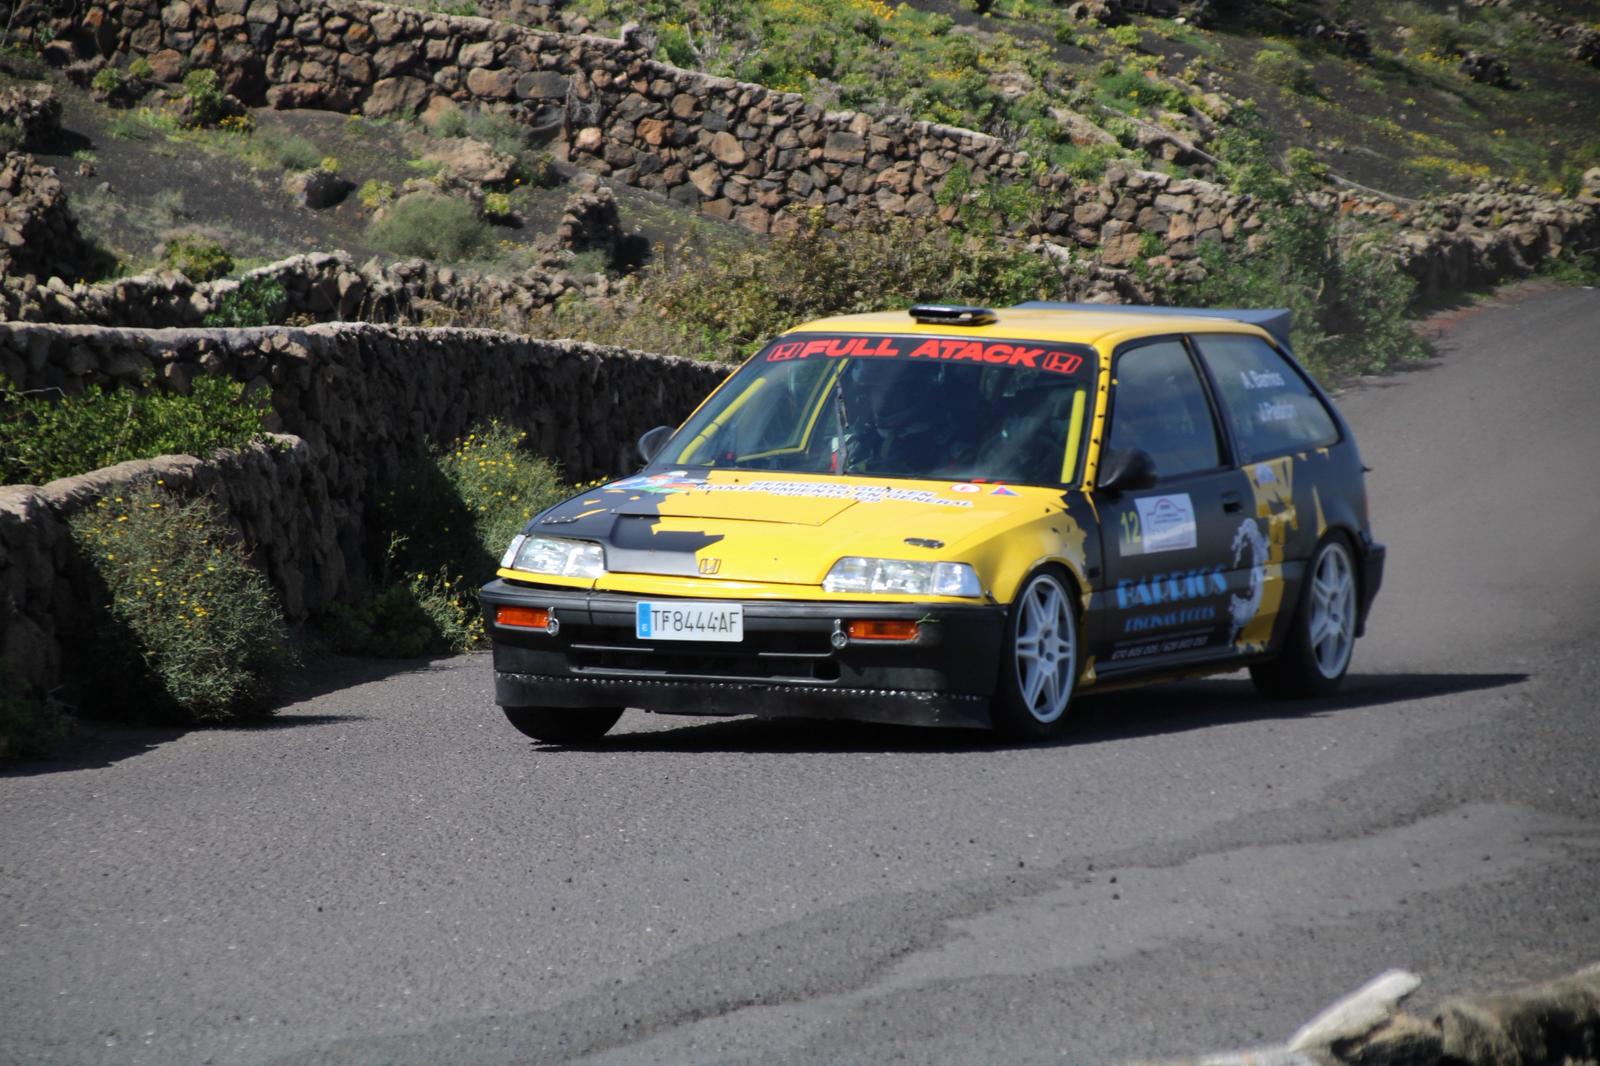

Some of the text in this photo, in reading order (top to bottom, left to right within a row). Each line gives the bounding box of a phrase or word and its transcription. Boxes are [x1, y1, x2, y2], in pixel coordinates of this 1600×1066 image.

[798, 338, 1047, 368] FULL ATACK
[695, 484, 850, 496] MANTENIMIENTO
[855, 490, 881, 499] EN
[886, 493, 972, 507] GENERAL
[751, 481, 849, 492] SERVICIOS
[1121, 511, 1141, 545] 12
[1117, 563, 1228, 609] BARRIOS
